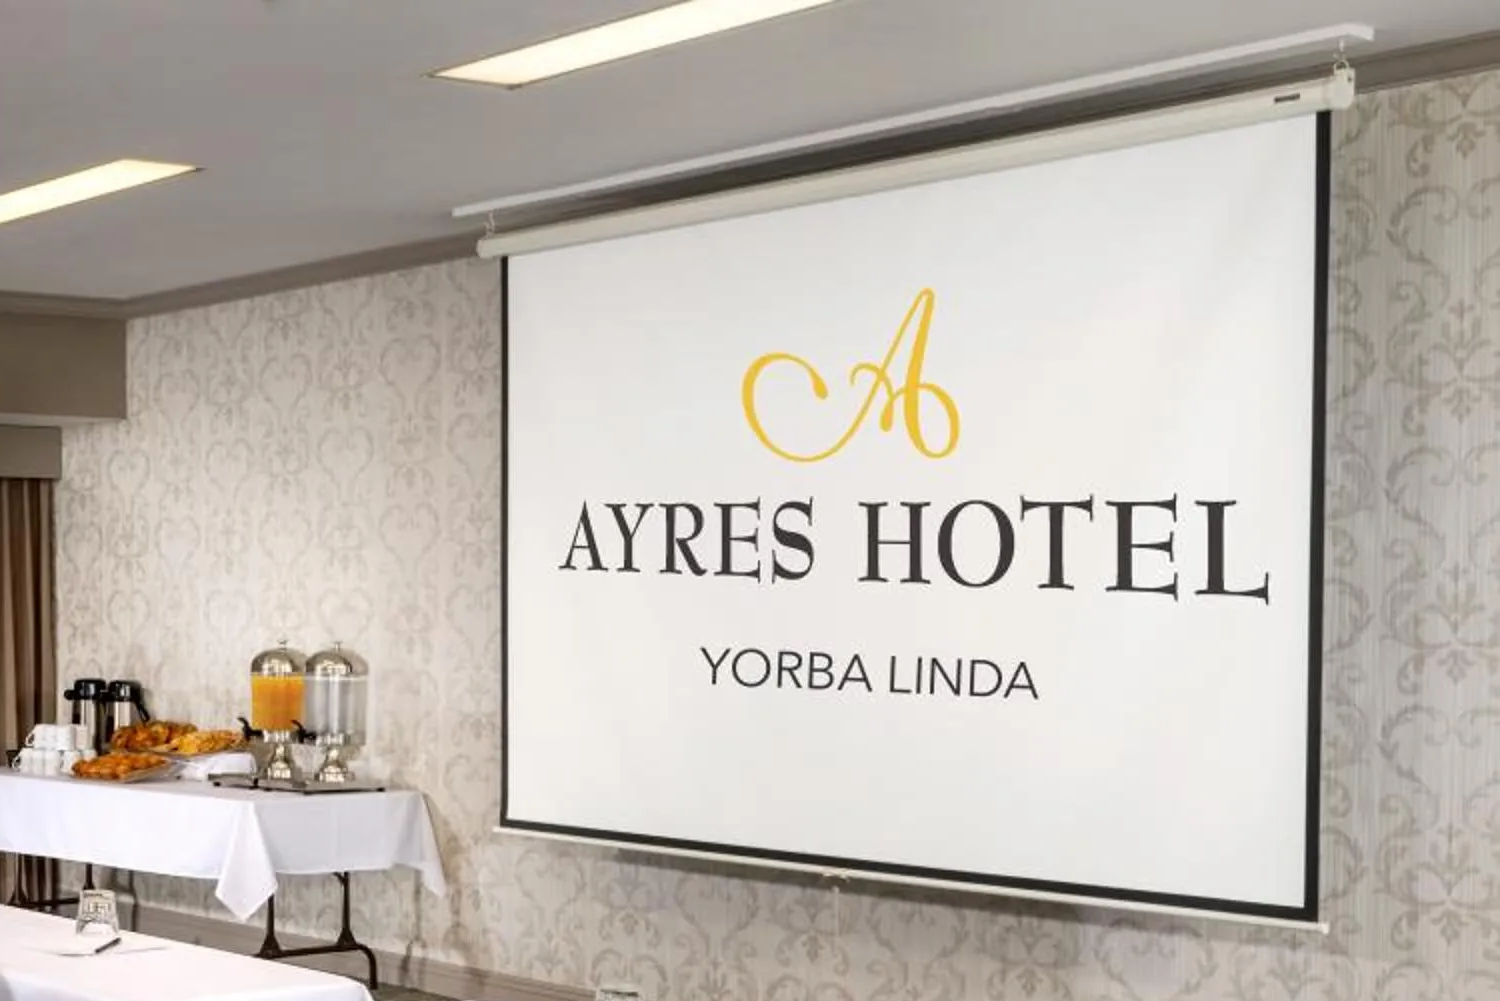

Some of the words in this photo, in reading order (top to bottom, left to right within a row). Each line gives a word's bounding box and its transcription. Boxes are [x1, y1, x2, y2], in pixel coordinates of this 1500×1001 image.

[558, 496, 816, 585] AYRES
[858, 493, 1270, 606] HOTEL
[700, 646, 873, 693] YORBA
[889, 655, 1040, 701] LINDA
